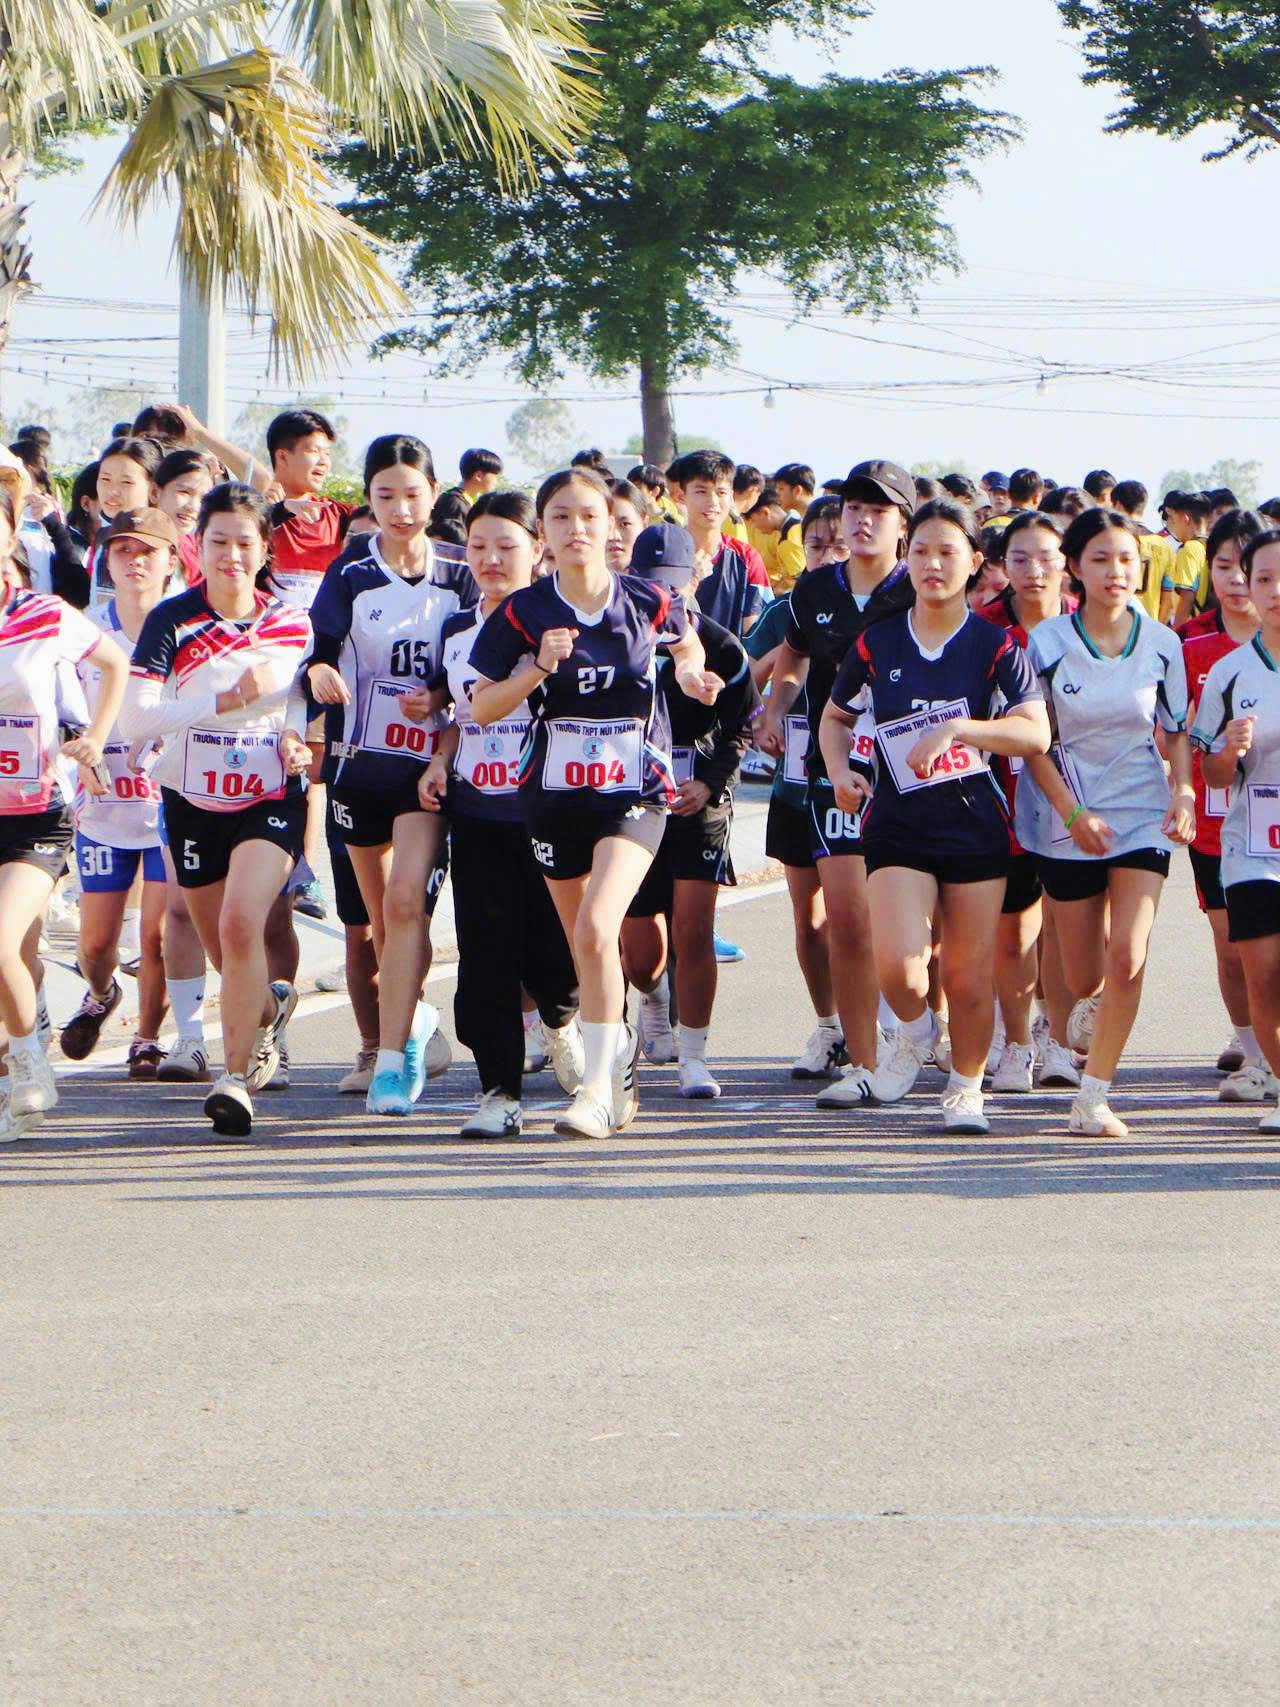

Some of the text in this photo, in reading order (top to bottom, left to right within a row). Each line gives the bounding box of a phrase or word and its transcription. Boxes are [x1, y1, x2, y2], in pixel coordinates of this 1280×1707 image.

[390, 639, 432, 680] 05
[577, 665, 616, 694] 27
[554, 723, 581, 735] TRƯỜNG
[582, 726, 598, 736] THPT
[614, 723, 636, 734] THÀNH
[912, 719, 928, 730] THPT
[193, 733, 221, 745] TRƯỜNG
[385, 723, 440, 755] 001
[203, 770, 264, 797] 104
[472, 761, 520, 787] 003
[565, 760, 626, 788] 004
[331, 800, 353, 829] 05
[825, 808, 861, 839] 09
[81, 846, 113, 876] 30
